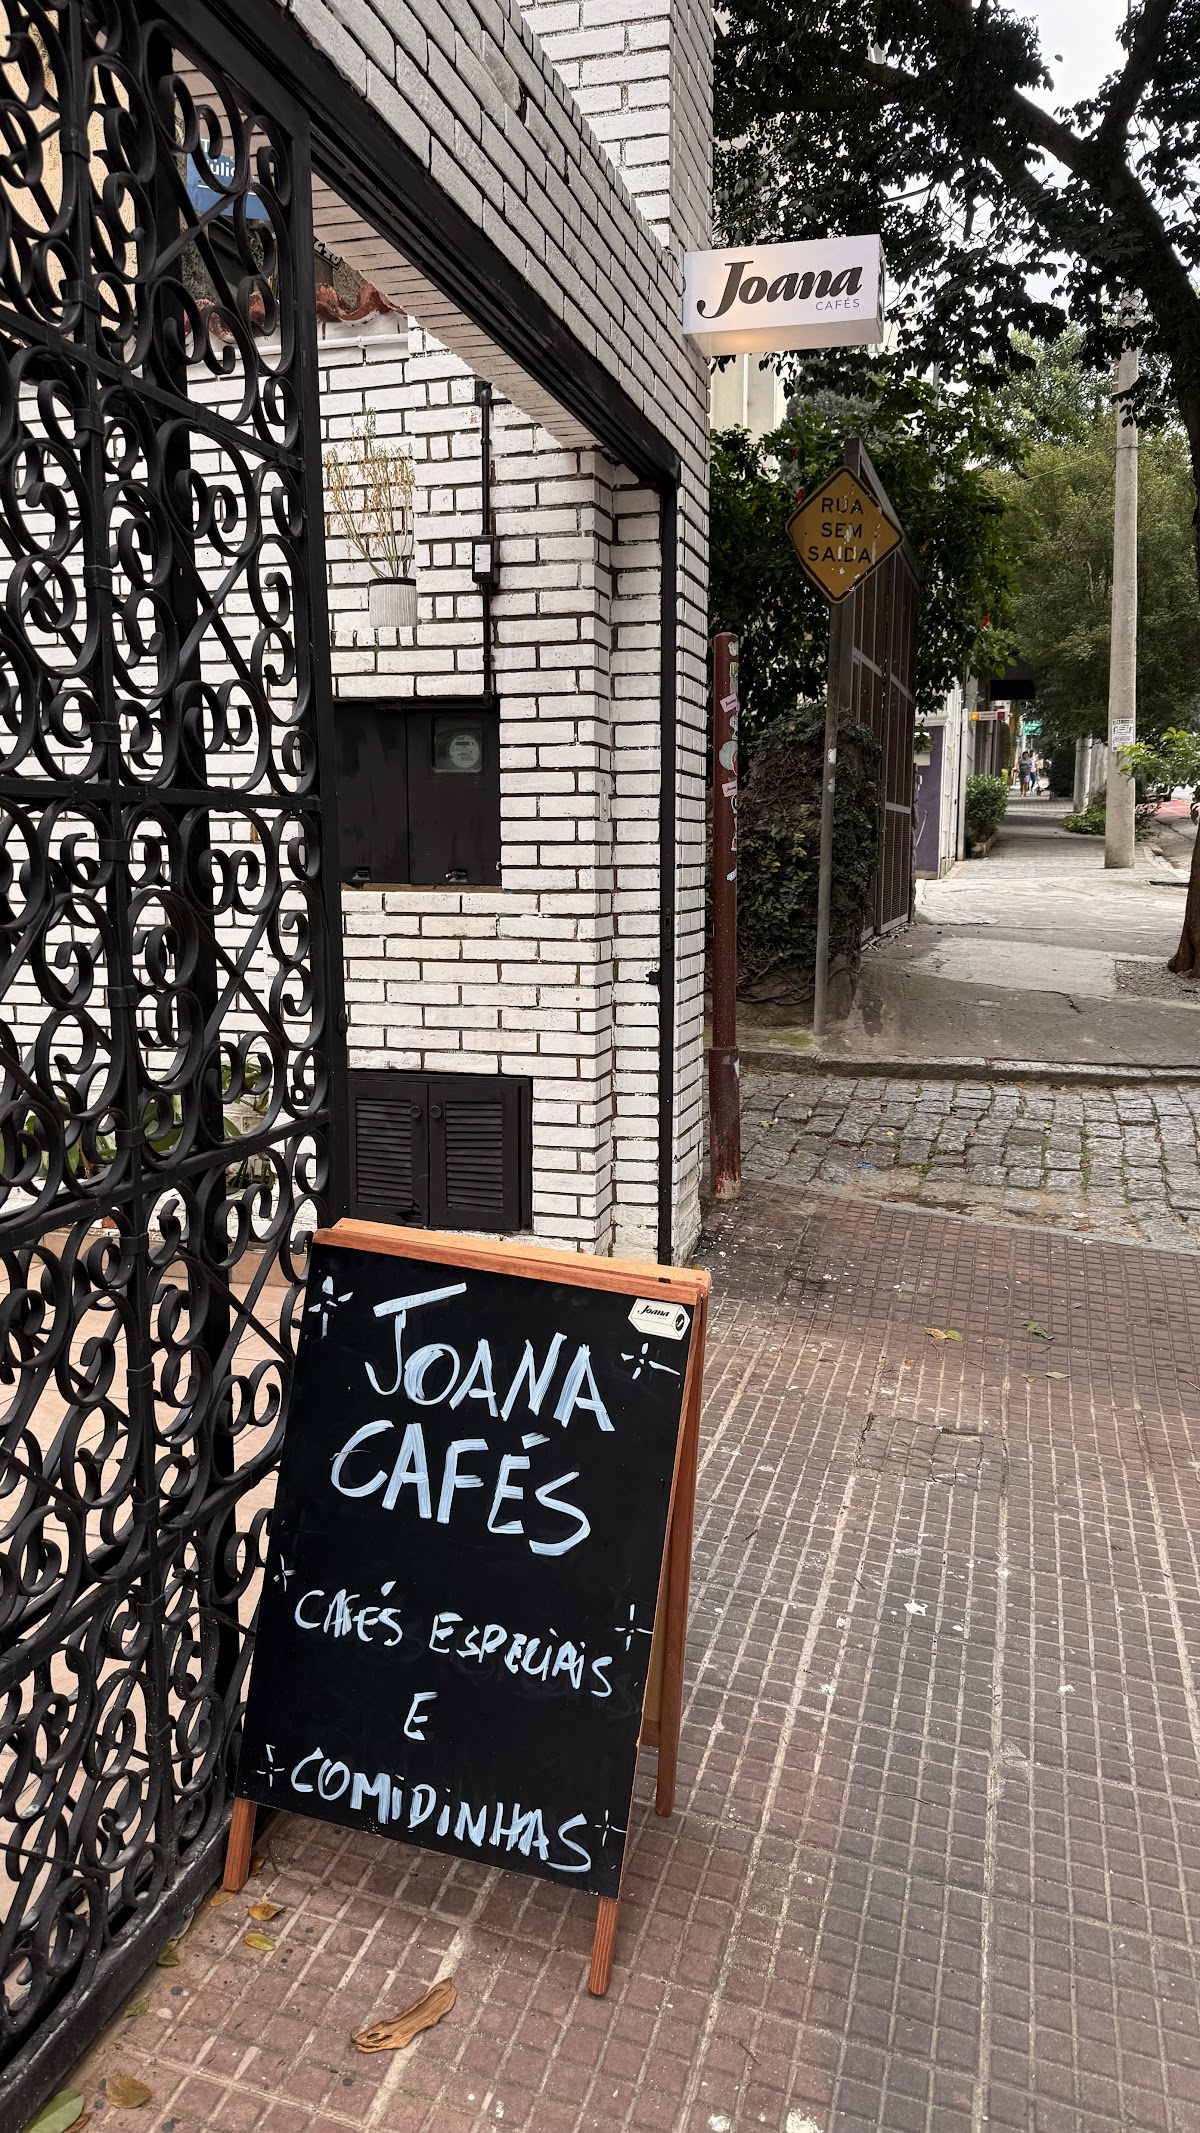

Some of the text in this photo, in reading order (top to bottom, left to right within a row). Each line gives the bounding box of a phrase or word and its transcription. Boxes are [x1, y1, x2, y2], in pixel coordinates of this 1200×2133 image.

[696, 260, 863, 319] Joana
[815, 298, 860, 311] CAFÉS
[821, 497, 864, 514] RUA
[821, 522, 863, 538] SEM
[637, 1304, 670, 1317] Joana
[365, 1282, 615, 1432] JOANA
[330, 1419, 591, 1556] CAFÉS
[294, 1580, 403, 1647] CAFÉS
[403, 1691, 438, 1741] E
